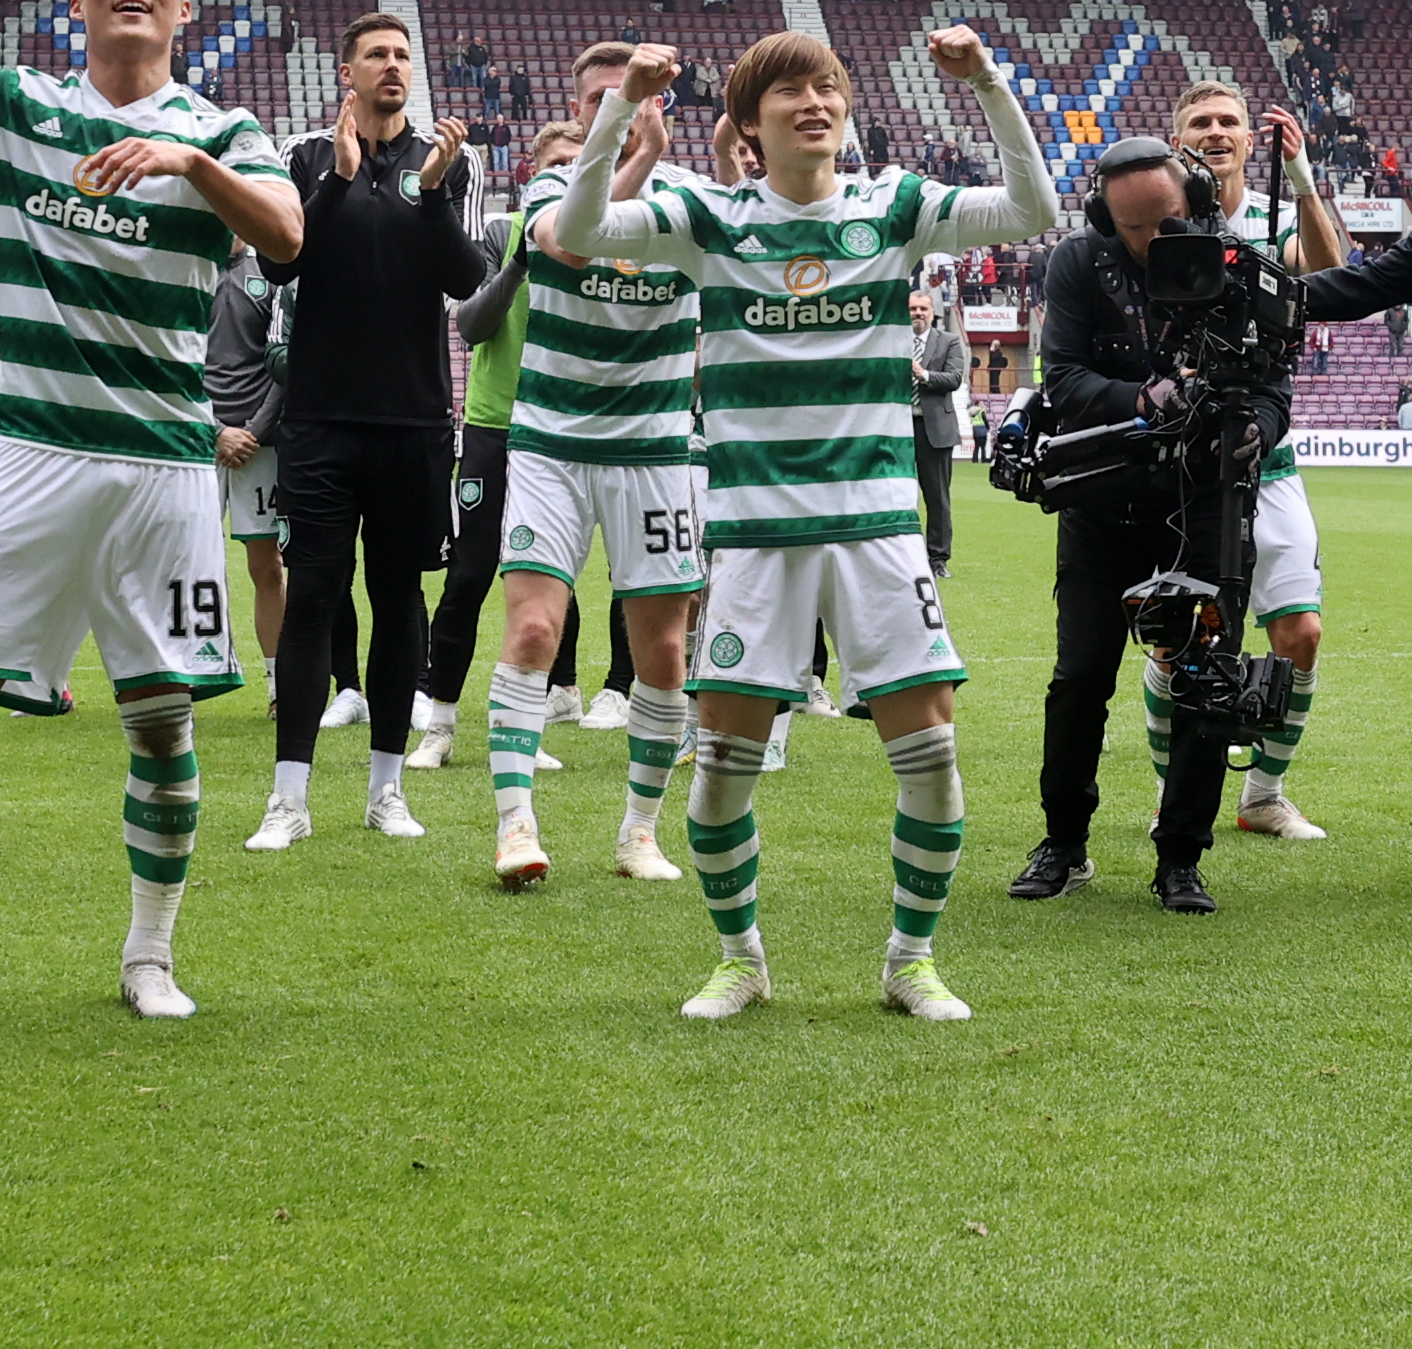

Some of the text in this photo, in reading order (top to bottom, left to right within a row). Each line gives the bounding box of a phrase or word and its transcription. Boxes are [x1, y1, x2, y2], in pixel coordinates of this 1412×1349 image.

[25, 188, 149, 242] dafabet
[580, 274, 677, 303] dafabet
[744, 296, 873, 331] dafabet
[255, 484, 277, 516] 14
[643, 508, 693, 554] 56
[168, 580, 224, 638] 19
[915, 577, 944, 630] 8
